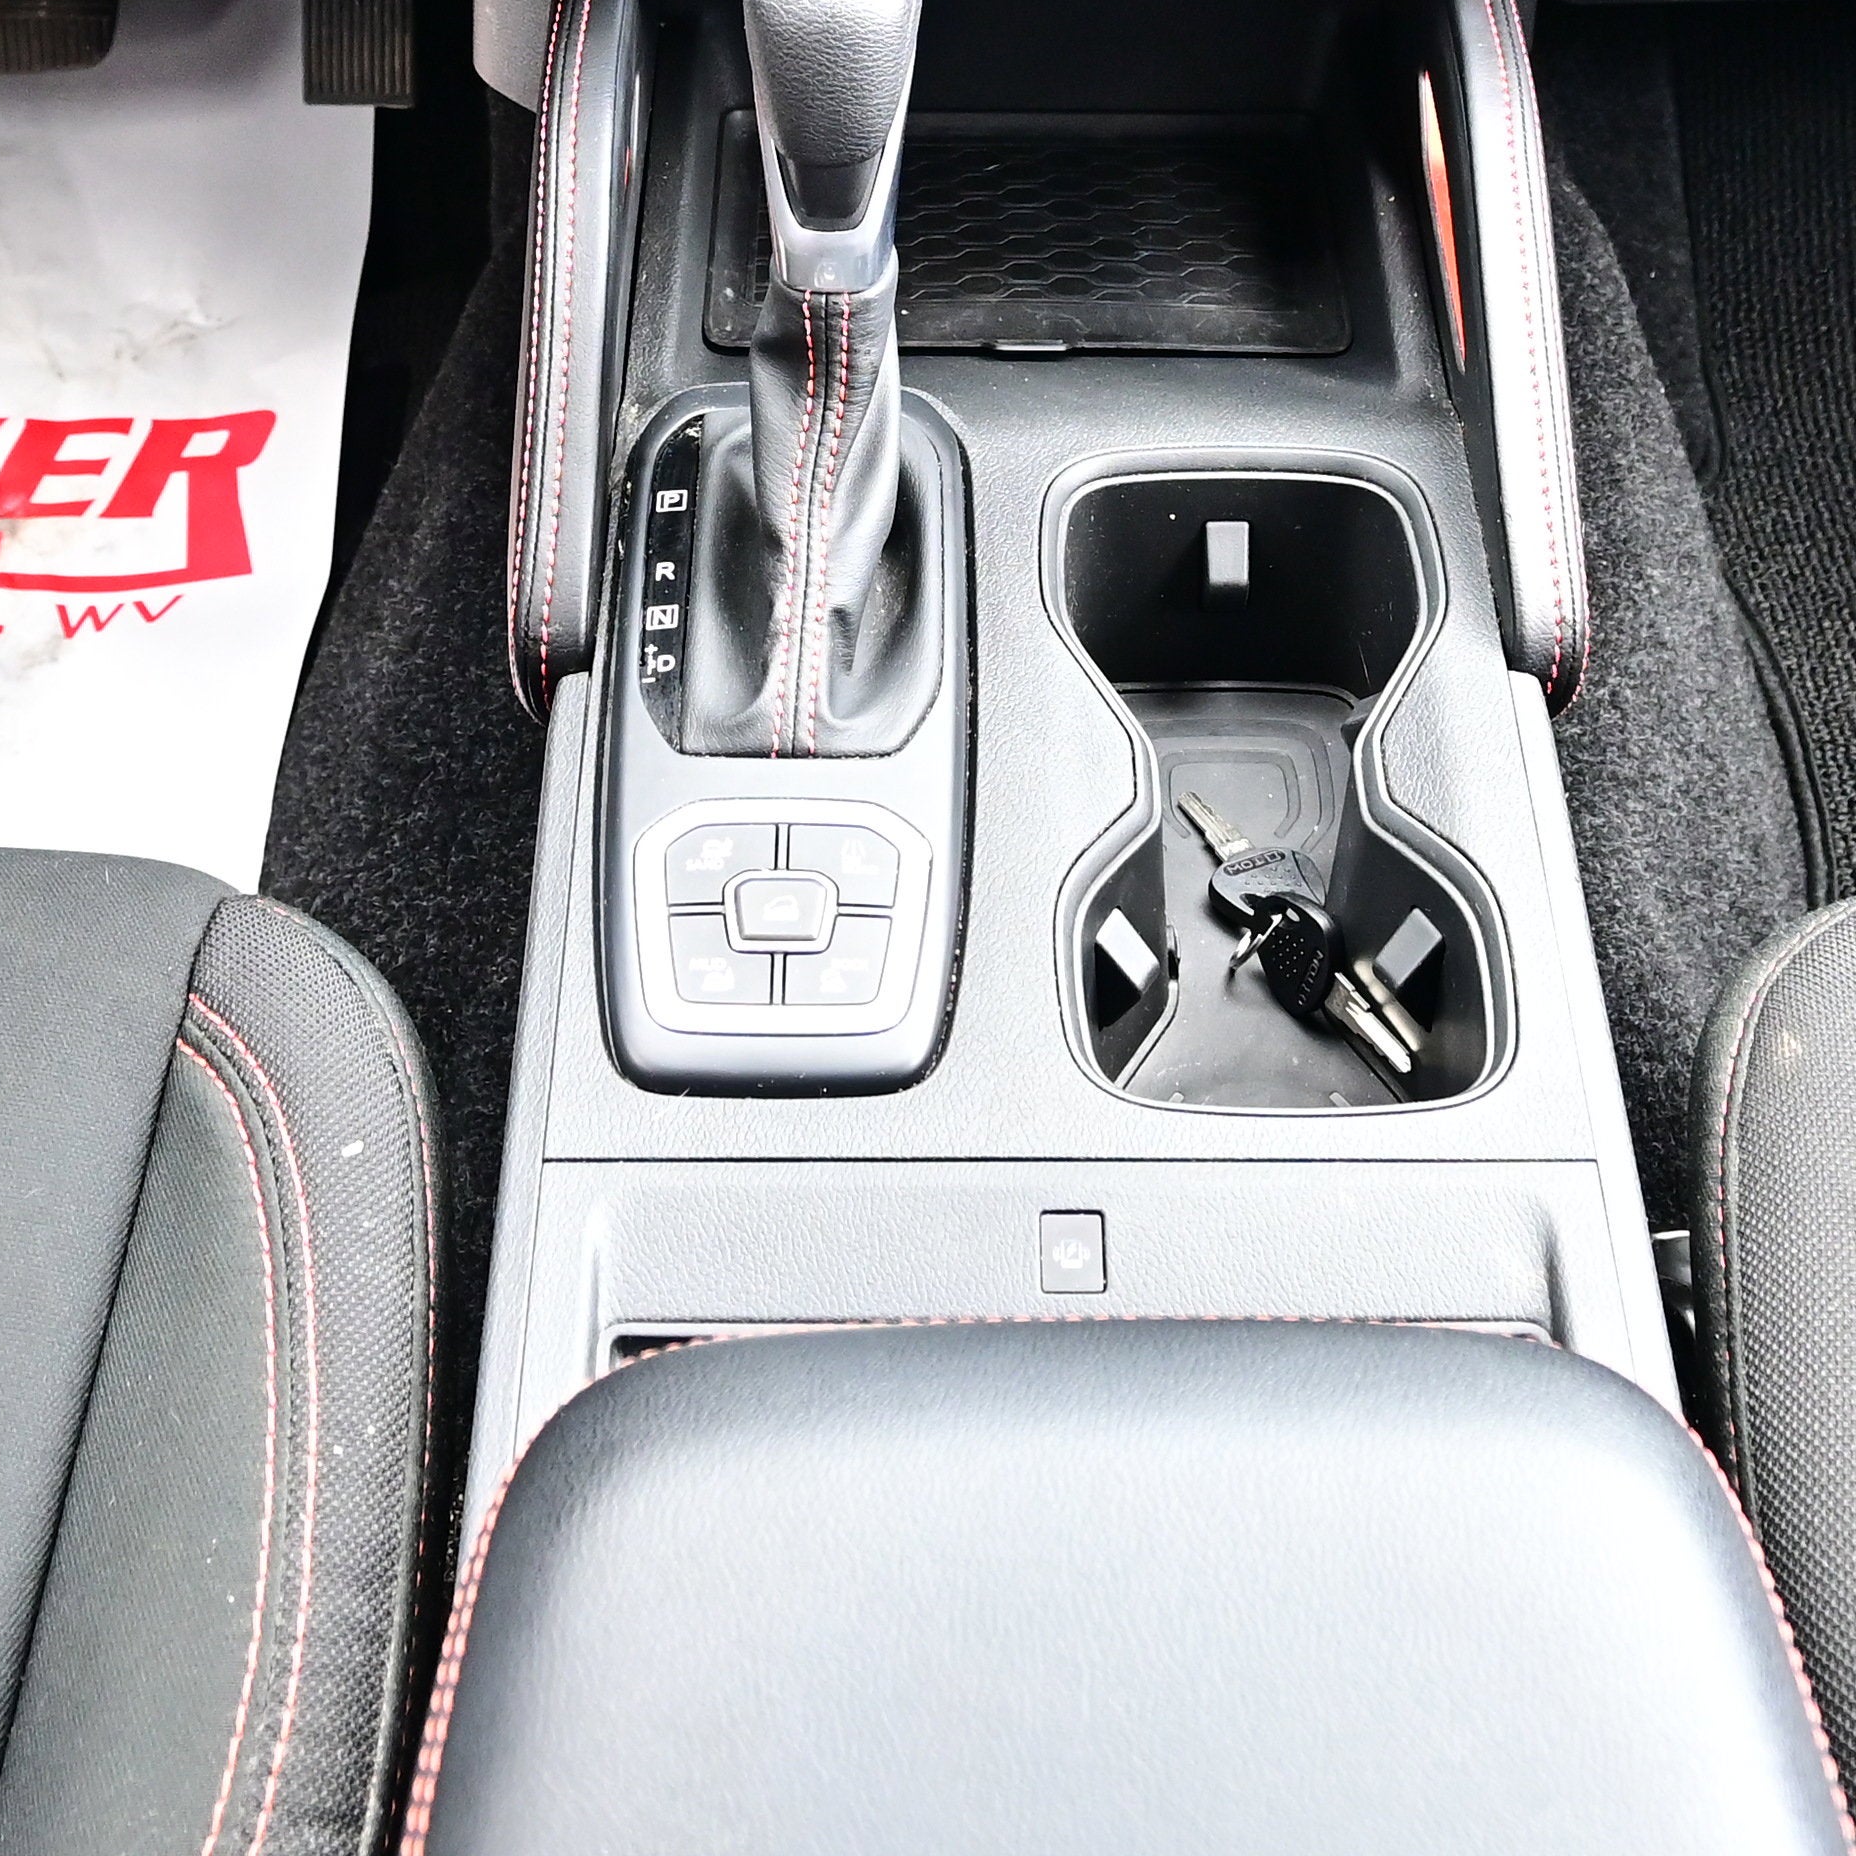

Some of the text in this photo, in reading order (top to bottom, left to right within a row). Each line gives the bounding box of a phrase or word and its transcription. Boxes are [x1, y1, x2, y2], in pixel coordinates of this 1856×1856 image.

[656, 562, 674, 579] R
[55, 593, 186, 638] WV
[651, 606, 673, 625] N
[659, 654, 675, 672] D
